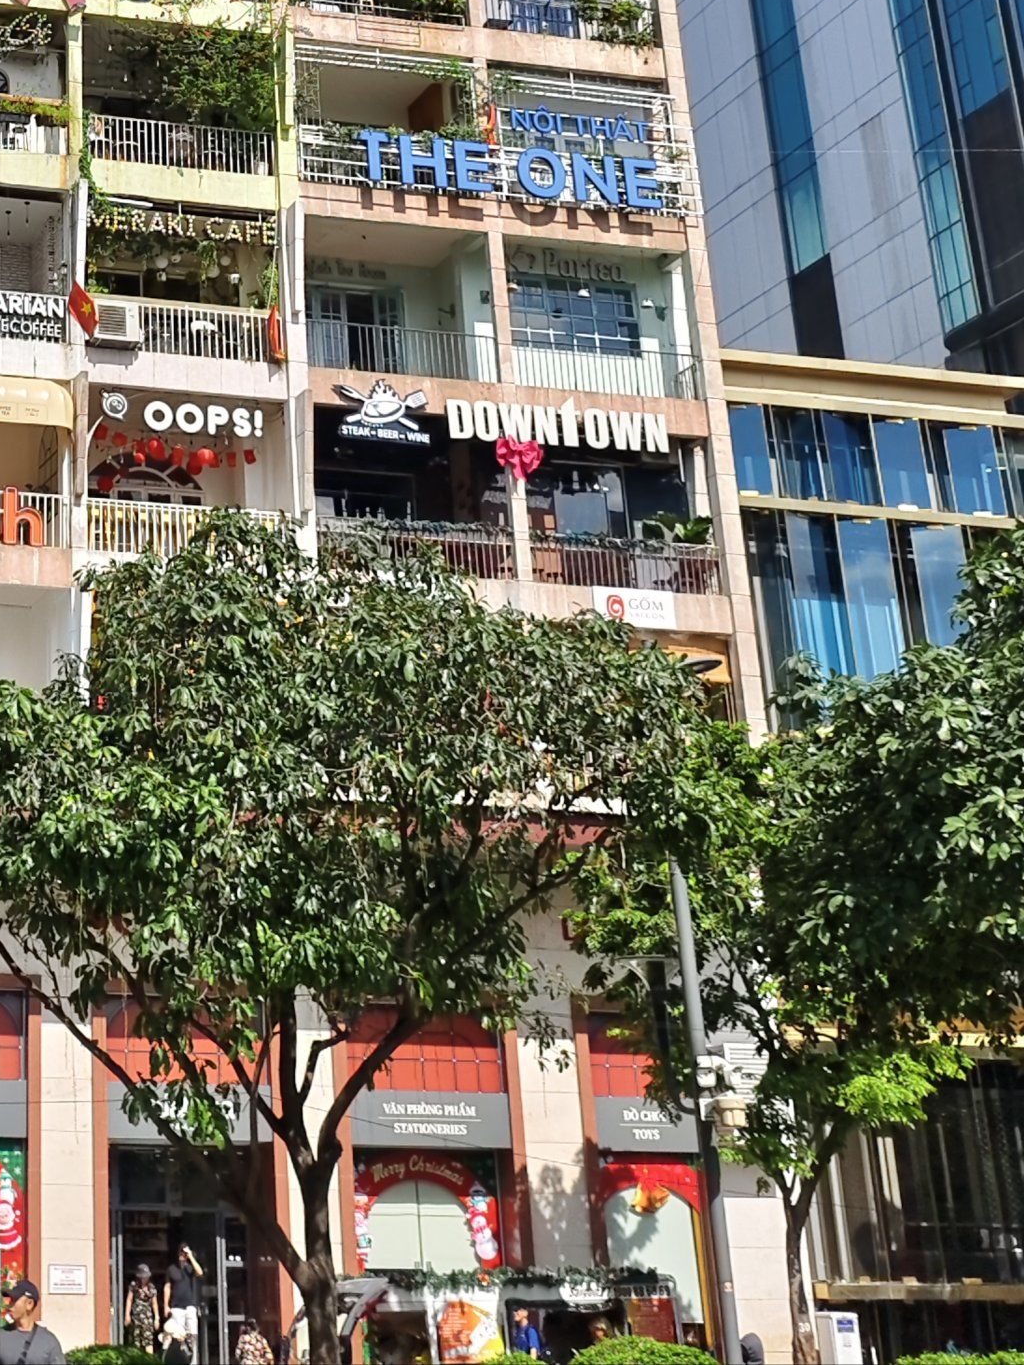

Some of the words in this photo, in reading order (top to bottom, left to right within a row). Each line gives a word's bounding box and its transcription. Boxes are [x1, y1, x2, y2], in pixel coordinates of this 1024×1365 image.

[510, 105, 563, 136] NỘI
[576, 112, 652, 145] THẤT
[358, 129, 494, 193] THE
[517, 147, 663, 210] ONE
[10, 319, 62, 338] COFFEE
[143, 400, 263, 438] OOPS!
[341, 425, 371, 437] STEAK
[377, 428, 399, 440] BEER
[406, 432, 430, 444] WINE
[382, 1101, 405, 1114] VĂN
[406, 1101, 443, 1115] PHÒNG
[393, 1122, 468, 1135] STATIONERIES
[632, 1128, 660, 1140] TOYS
